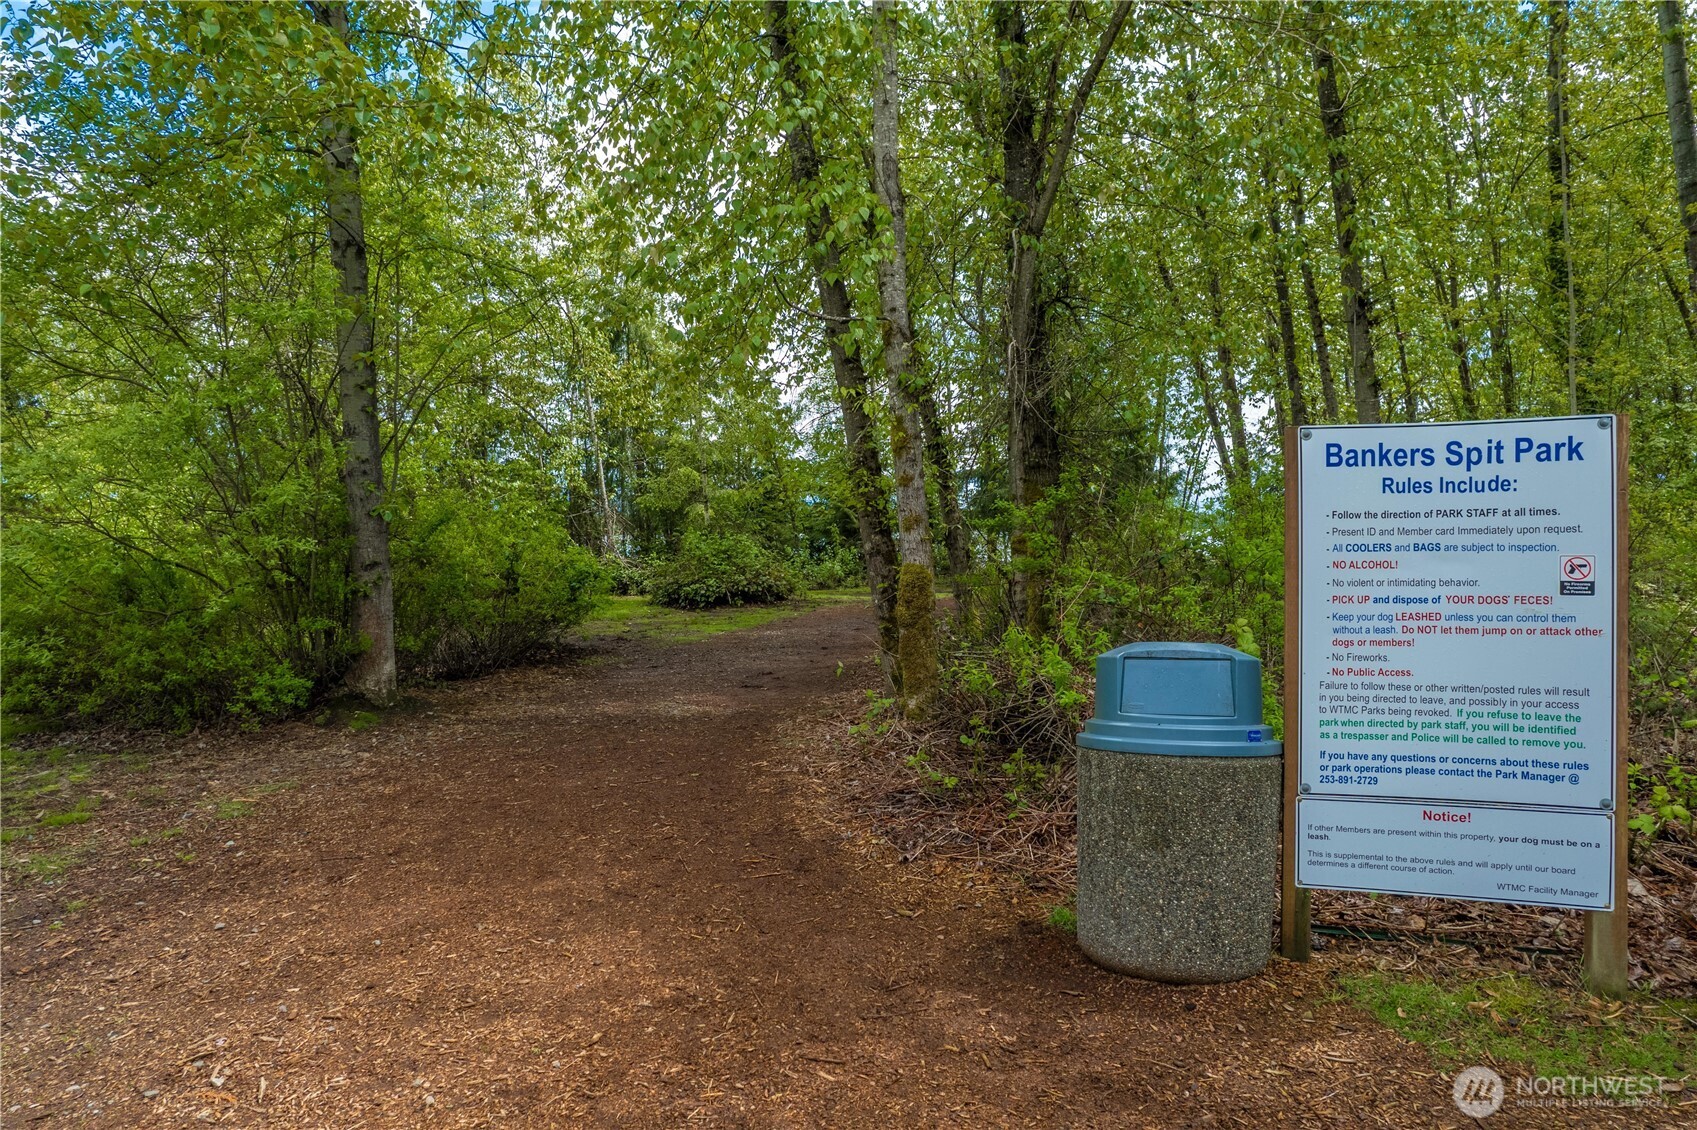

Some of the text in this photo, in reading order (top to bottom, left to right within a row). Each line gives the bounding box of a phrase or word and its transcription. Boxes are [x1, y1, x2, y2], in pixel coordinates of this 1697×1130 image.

[1325, 436, 1584, 472] Bankers Spit Park
[1382, 475, 1517, 494] Rules Include:
[1332, 507, 1560, 519] Follow the direction of PARK STAFF at all times.
[1332, 524, 1583, 536] Present ID and Member card Immediately upon request.
[1332, 544, 1343, 552] All
[1346, 543, 1392, 552] COOLERS
[1394, 543, 1410, 552] and
[1413, 543, 1441, 552] BAGS
[1461, 543, 1494, 554] subject
[1497, 543, 1505, 551] to
[1508, 542, 1559, 554] inspection.
[1333, 560, 1398, 569] NO ALCOHOL!
[1332, 579, 1344, 587] No
[1347, 578, 1374, 587] violent
[1388, 578, 1436, 589] intimidating
[1439, 578, 1480, 587] behavior.
[1332, 595, 1354, 604] PICK
[1357, 595, 1370, 604] UP
[1373, 595, 1390, 604] and
[1392, 595, 1429, 606] dispose
[1432, 595, 1441, 604] of
[1446, 595, 1474, 604] YOUR
[1514, 596, 1552, 605] FECES!
[1332, 612, 1354, 623] Keep
[1356, 614, 1375, 623] your
[1377, 612, 1393, 623] dog
[1396, 612, 1442, 621] LEASHED
[1445, 613, 1474, 621] unless
[1476, 615, 1493, 624] you
[1516, 614, 1548, 622] control
[1552, 614, 1576, 622] them
[1332, 626, 1362, 634] without
[1373, 625, 1398, 634] leash.
[1402, 625, 1414, 634] Do
[1417, 625, 1438, 634] NOT
[1441, 626, 1452, 634] let
[1455, 626, 1479, 634] them
[1482, 626, 1507, 637] jump
[1540, 627, 1571, 636] attack
[1575, 627, 1603, 636] other
[1332, 638, 1354, 648] dogs
[1370, 638, 1414, 647] members!
[1332, 653, 1390, 662] No Fireworks.
[1332, 668, 1414, 676] No Public Access.
[1320, 681, 1348, 690] Failure
[1361, 682, 1385, 690] follow
[1388, 682, 1411, 691] these
[1425, 684, 1448, 692] other
[1451, 684, 1515, 695] written/posted
[1518, 686, 1541, 695] rules
[1544, 687, 1559, 695] will
[1563, 688, 1590, 696] result
[1320, 718, 1576, 735] park when directed by park staff, you will be identified
[1320, 775, 1378, 785] 253-891-2729
[1332, 764, 1351, 773] park
[1354, 765, 1402, 774] operations
[1406, 766, 1436, 776] please
[1438, 768, 1474, 777] contact
[1477, 769, 1492, 778] the
[1496, 770, 1518, 779] Park
[1521, 771, 1566, 784] Manager
[1568, 773, 1580, 785] @
[1422, 810, 1472, 822] Notice!
[1336, 826, 1370, 834] Members
[1460, 834, 1495, 843] property,
[1521, 836, 1538, 846] dog
[1307, 859, 1348, 868] determines
[1358, 862, 1388, 870] different
[1334, 853, 1383, 861] supplemental
[1491, 863, 1513, 871] apply
[1551, 866, 1576, 874] board
[1497, 883, 1598, 898] WTMC Facility Manager
